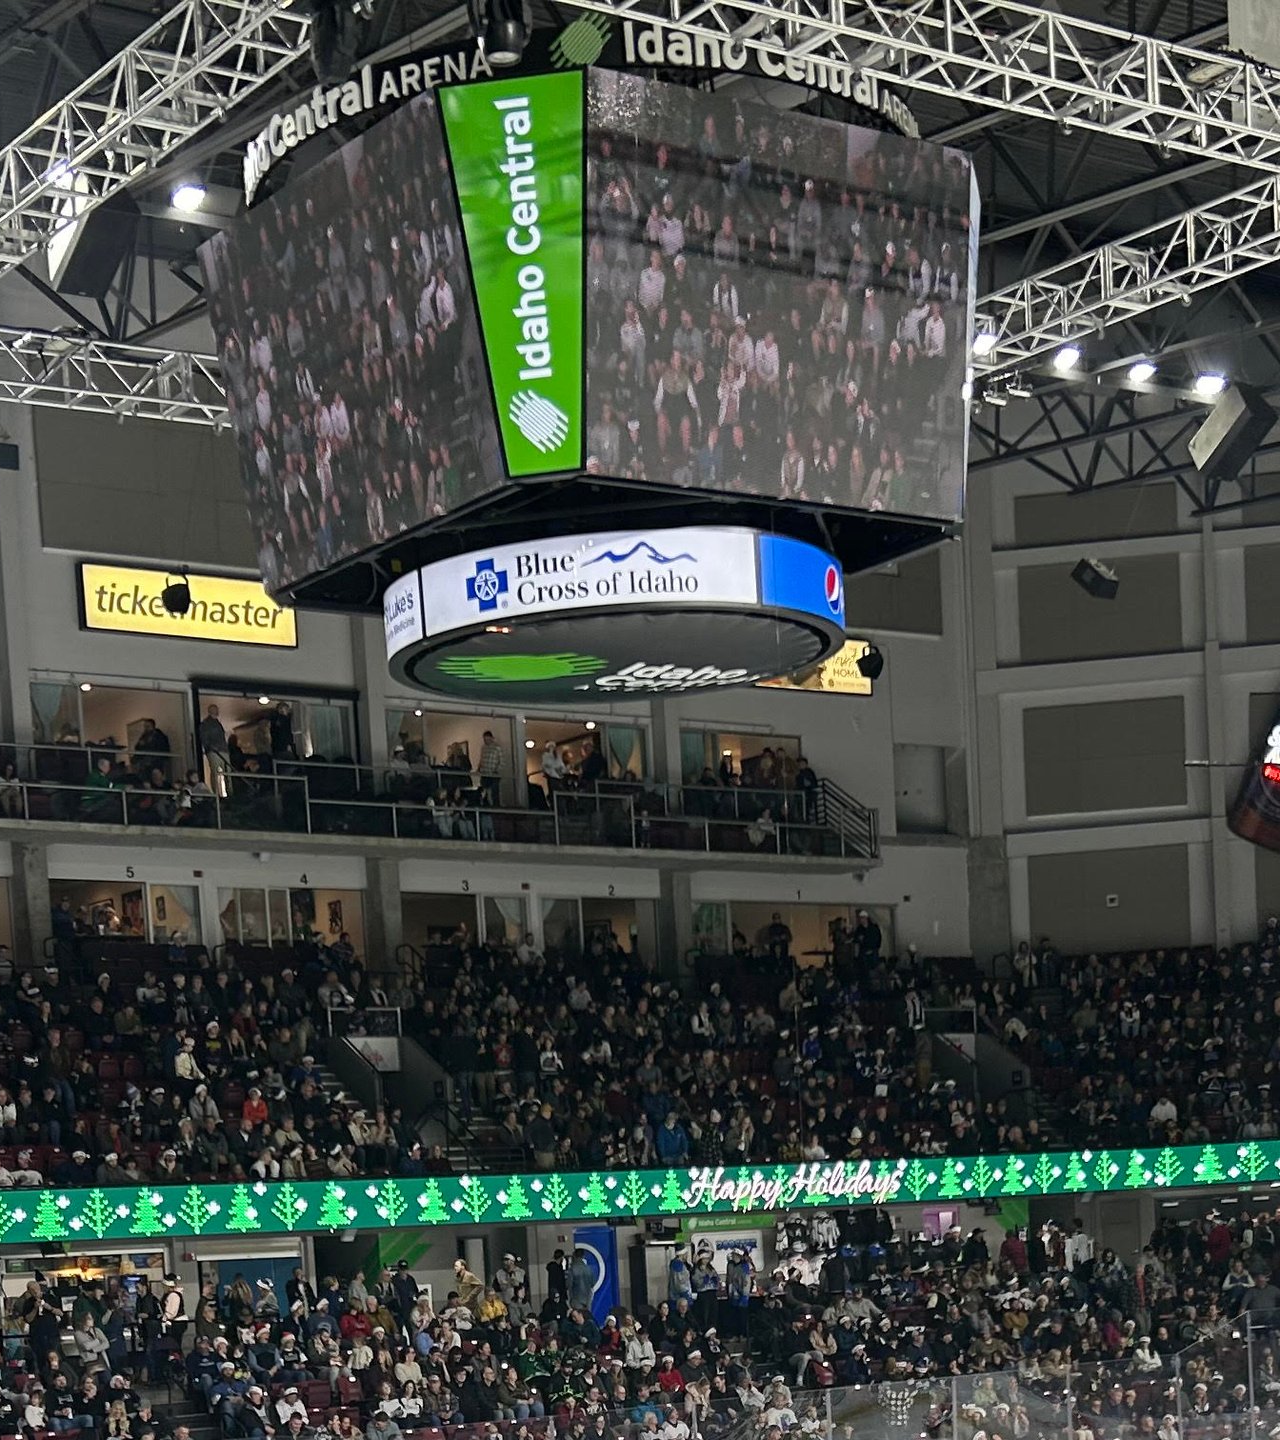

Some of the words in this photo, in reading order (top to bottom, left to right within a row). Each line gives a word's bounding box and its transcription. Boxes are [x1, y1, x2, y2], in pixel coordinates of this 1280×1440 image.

[269, 65, 375, 157] Central
[379, 47, 494, 103] ARENA
[492, 96, 541, 256] Central
[512, 264, 553, 381] Idaho
[515, 553, 576, 578] Blue
[95, 582, 284, 629] tickemaster
[517, 576, 590, 607] Cross
[596, 571, 619, 596] of
[629, 569, 699, 595] Idaho
[126, 866, 135, 879] 5
[299, 873, 308, 886] 4
[462, 880, 470, 892] 3
[687, 1166, 783, 1211] Happy
[789, 1159, 904, 1205] Holidays
